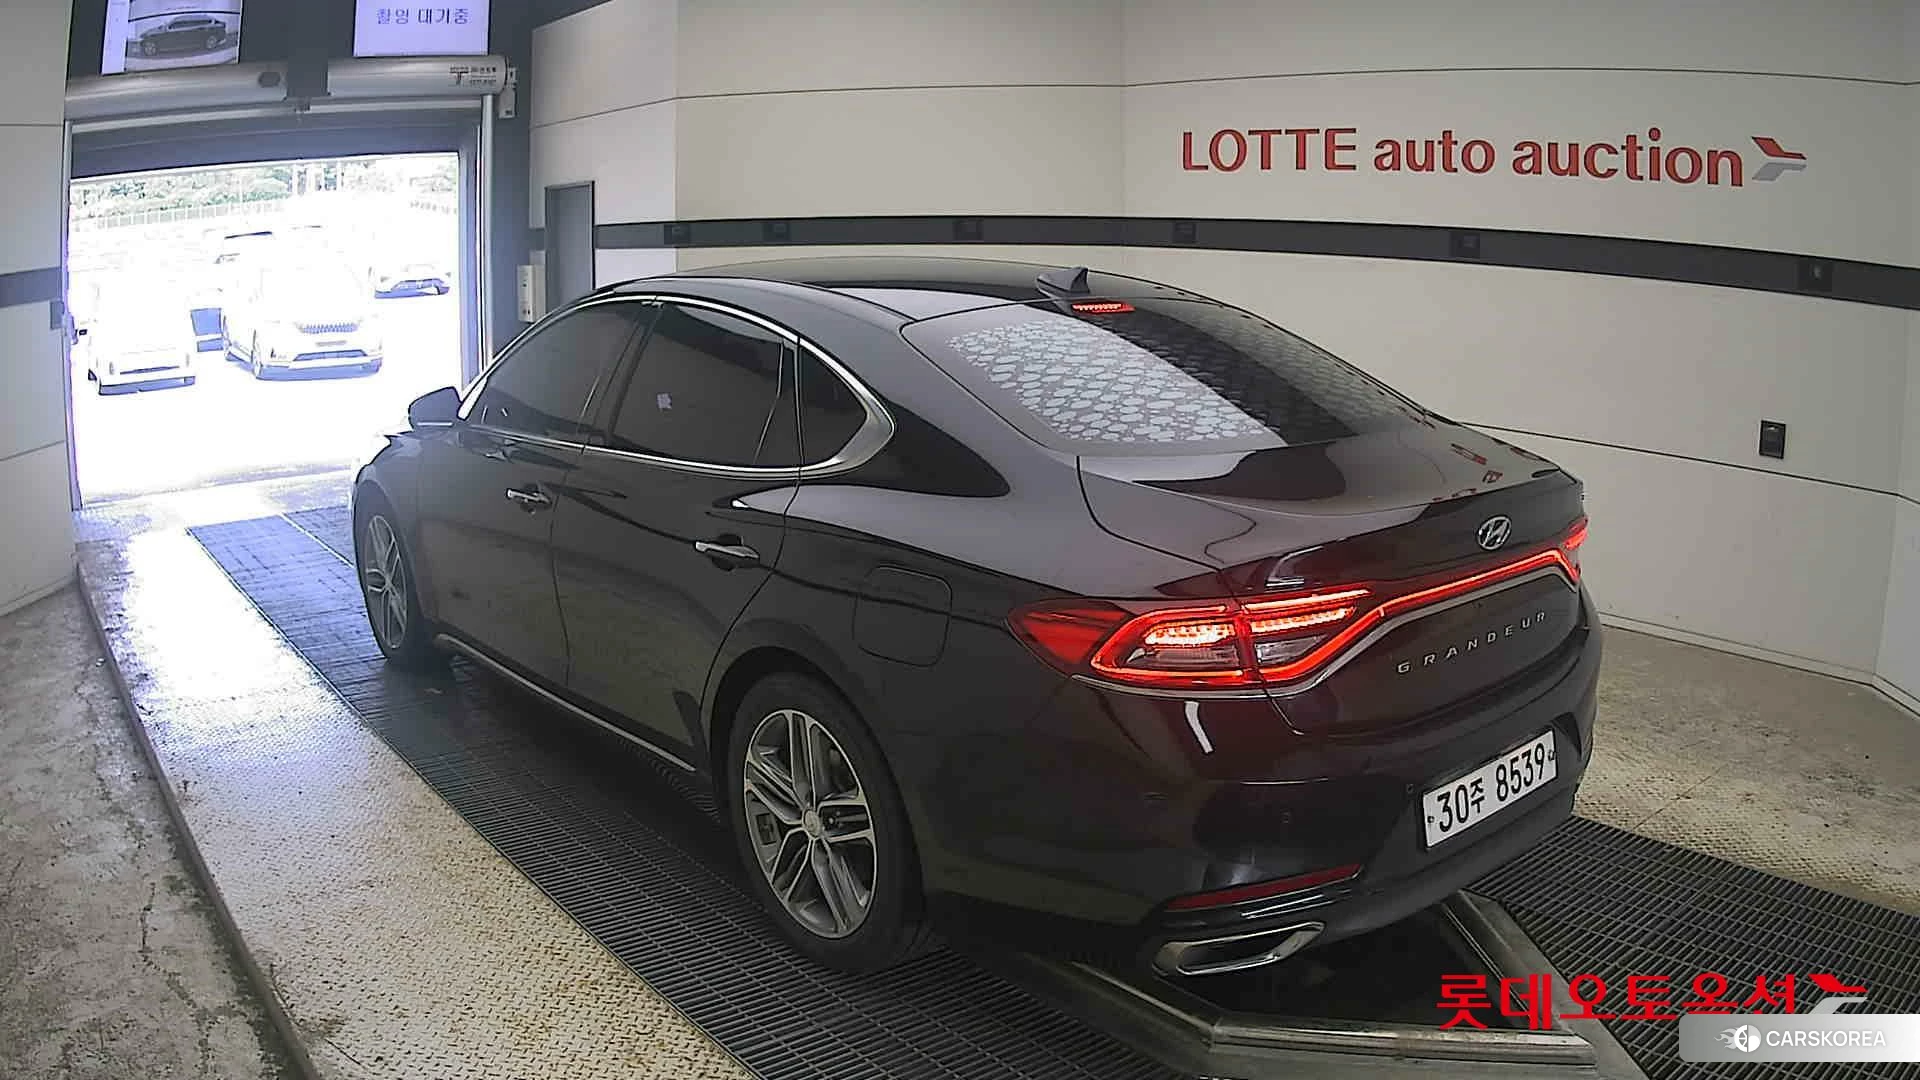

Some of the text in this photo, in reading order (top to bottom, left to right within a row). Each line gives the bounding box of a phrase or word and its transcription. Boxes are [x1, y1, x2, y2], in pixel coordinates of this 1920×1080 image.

[418, 8, 470, 24] 대기중
[1182, 127, 1744, 187] LOTTE auto auction
[1397, 611, 1546, 674] GRANDEUR
[1437, 743, 1546, 832] 30주 8539
